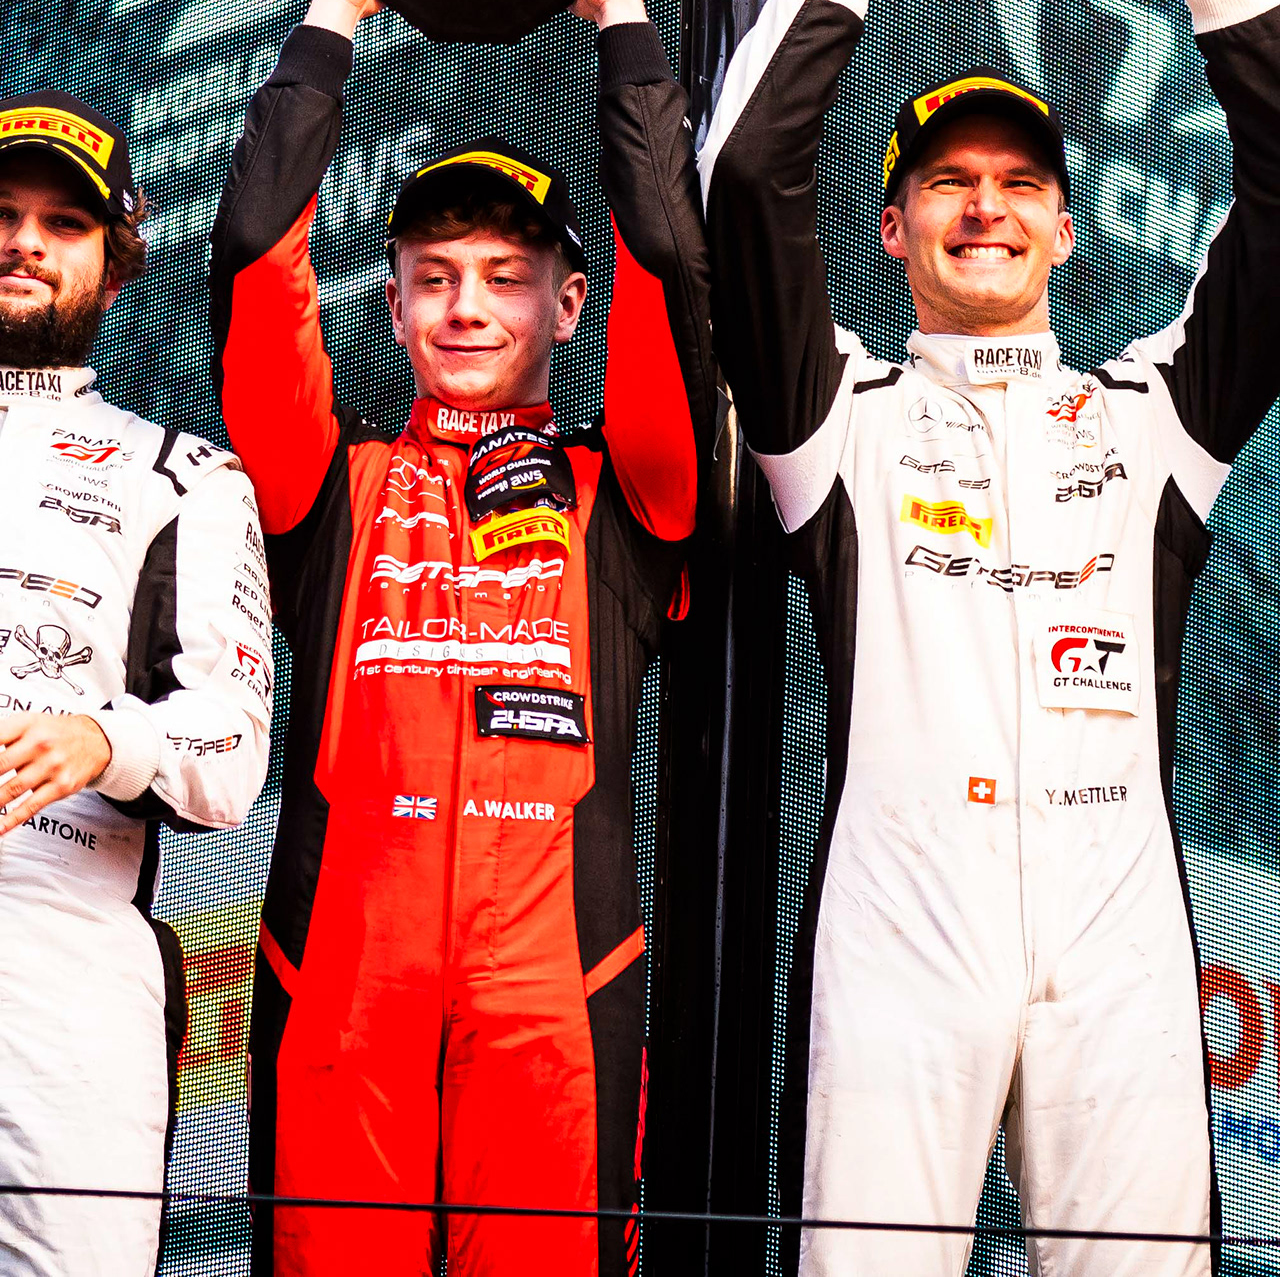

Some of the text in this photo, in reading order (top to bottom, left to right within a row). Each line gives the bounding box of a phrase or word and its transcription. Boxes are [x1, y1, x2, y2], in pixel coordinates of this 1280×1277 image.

[469, 430, 555, 465] FANATEC
[478, 457, 552, 486] WORLD CHALLENGE
[510, 469, 544, 486] aws
[234, 579, 259, 602] RED
[231, 594, 265, 631] Roger
[361, 615, 570, 644] TAILOR-MADE
[1047, 624, 1126, 640] INTERCONTINENTAL
[378, 642, 484, 660] DESIGNS
[230, 668, 248, 682] GT
[384, 663, 444, 677] century
[447, 663, 498, 677] timber
[503, 666, 572, 685] engineering
[1053, 677, 1132, 692] GT CHALLENGE
[493, 691, 574, 710] CROWDSTRIKE
[1044, 785, 1128, 807] Y.METTLER
[463, 799, 556, 822] A.WALKER
[22, 815, 97, 851] ARTONE
